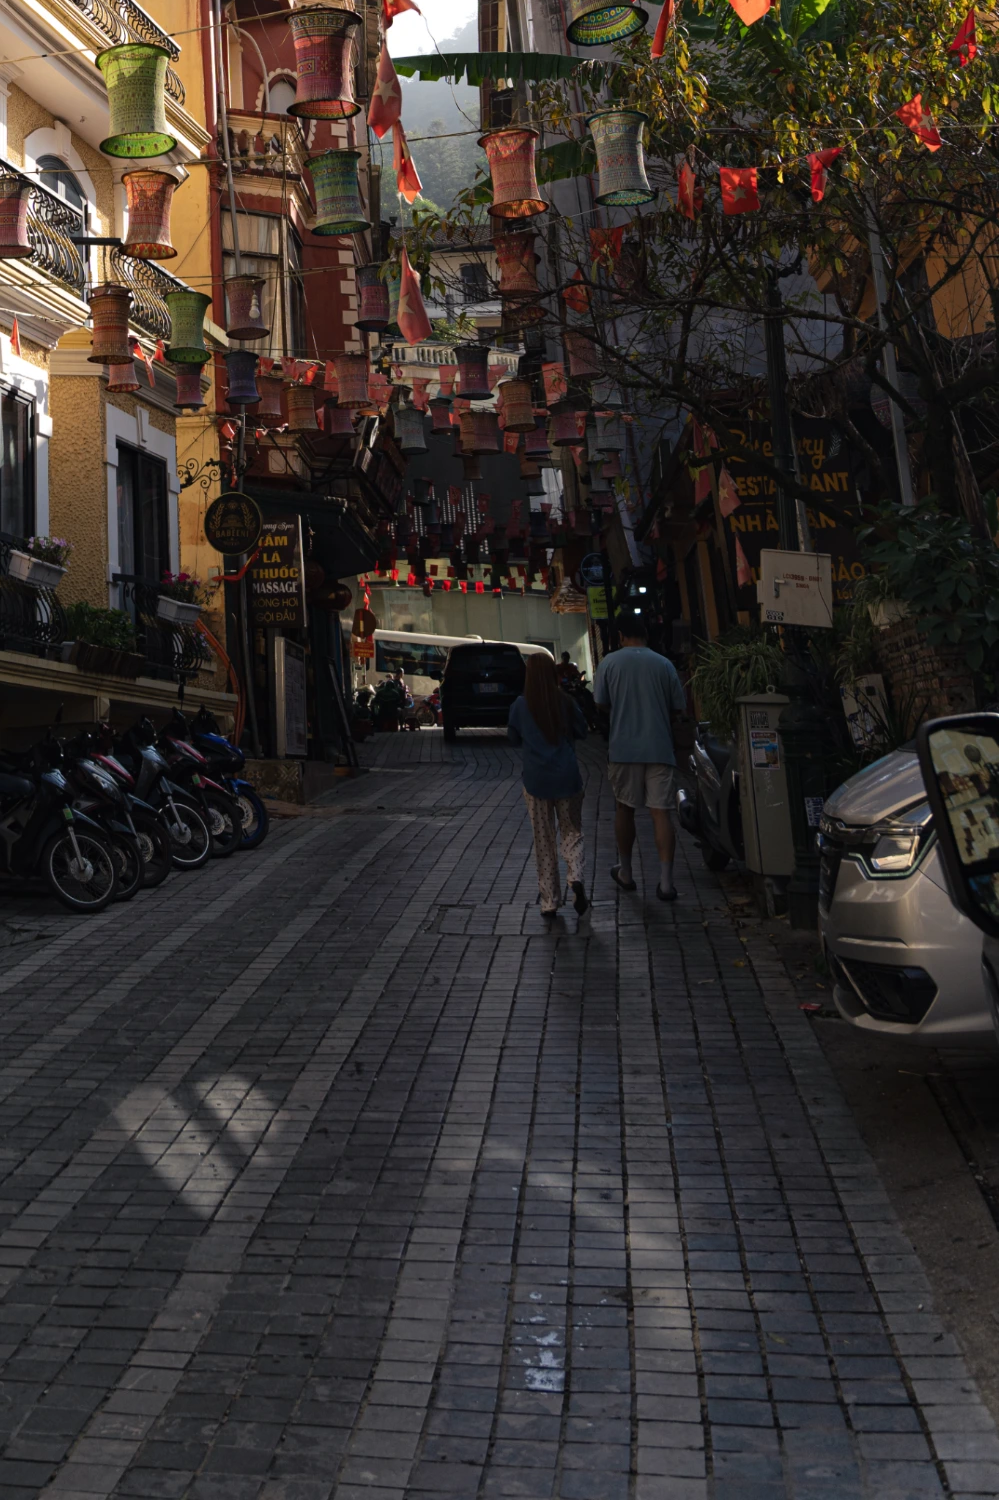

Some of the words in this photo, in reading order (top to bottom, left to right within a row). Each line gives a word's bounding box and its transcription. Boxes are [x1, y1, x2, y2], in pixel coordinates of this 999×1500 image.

[729, 508, 779, 532] NHÀ
[251, 564, 299, 579] THUỐC
[252, 580, 299, 594] MASSAGE
